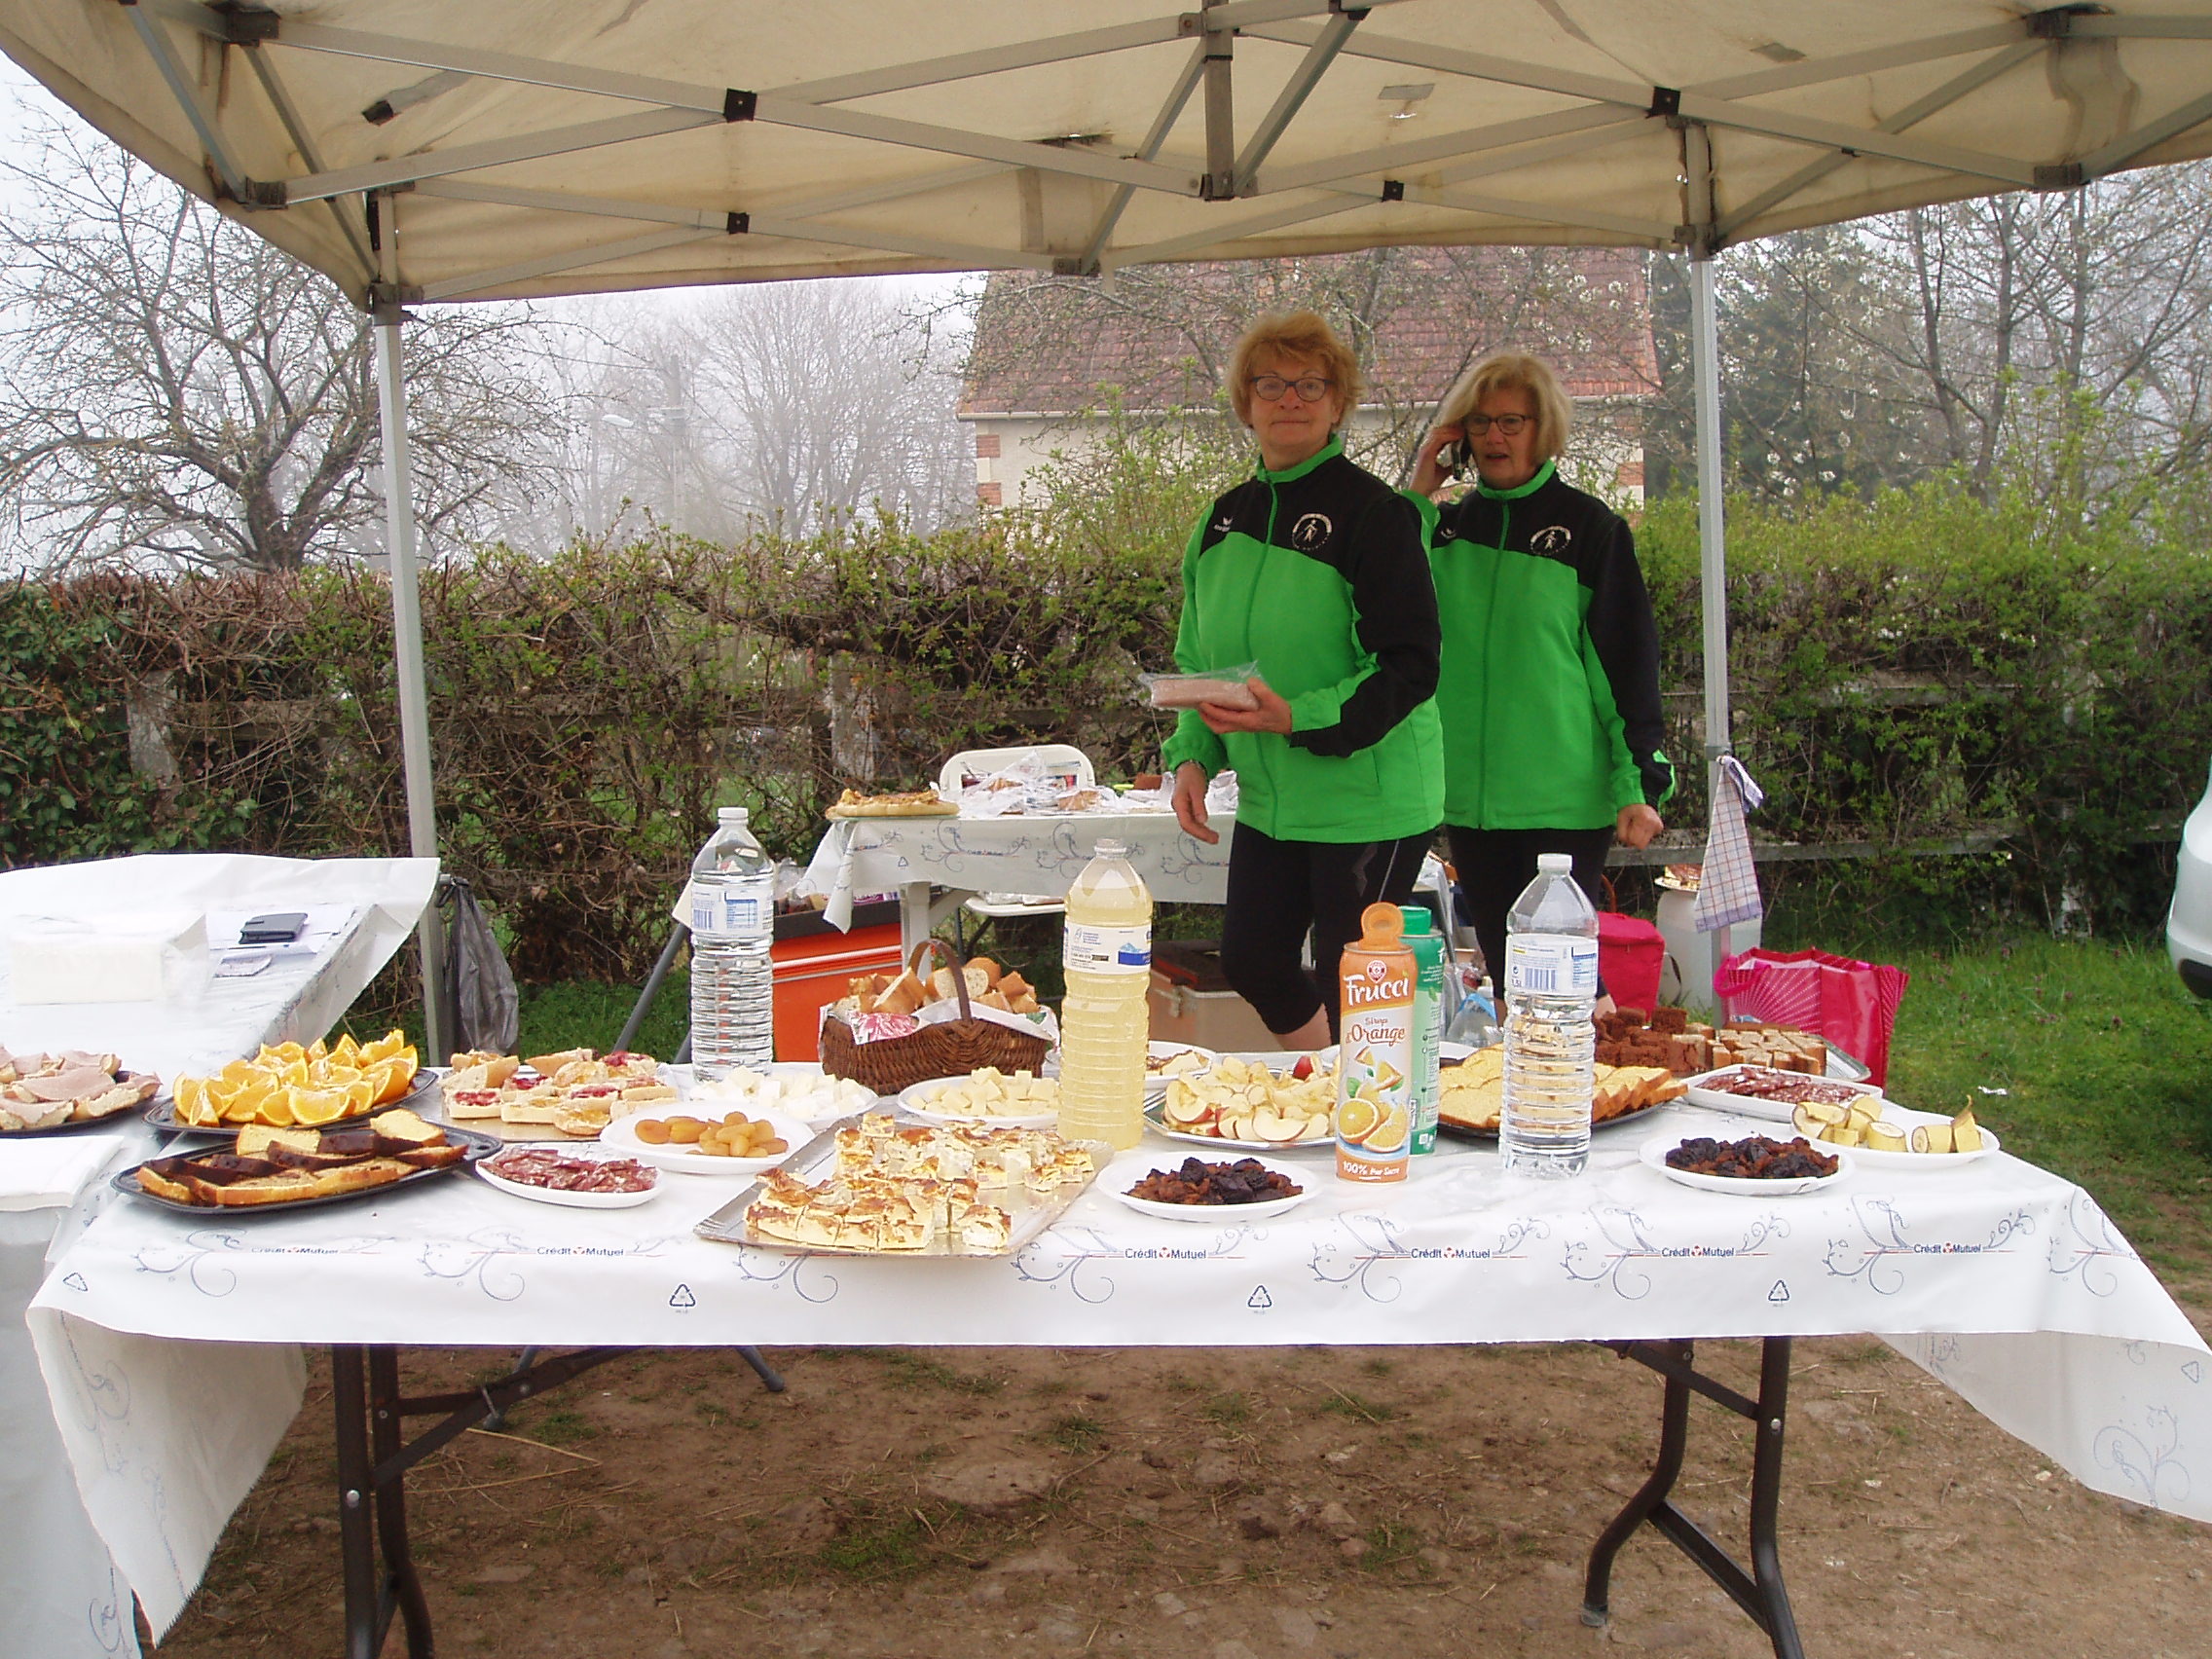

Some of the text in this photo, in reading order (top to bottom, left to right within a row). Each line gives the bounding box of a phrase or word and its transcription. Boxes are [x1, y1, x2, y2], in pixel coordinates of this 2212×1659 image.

[1344, 974, 1409, 1006] Frucci
[1344, 1161, 1367, 1175] 100%
[1124, 1247, 1207, 1259] Crédit Mutuel
[1411, 1247, 1491, 1259] Crédit Mutuel
[1661, 1246, 1735, 1257] Crédit Mutuel
[1913, 1243, 1981, 1254] Crédit Mutuel
